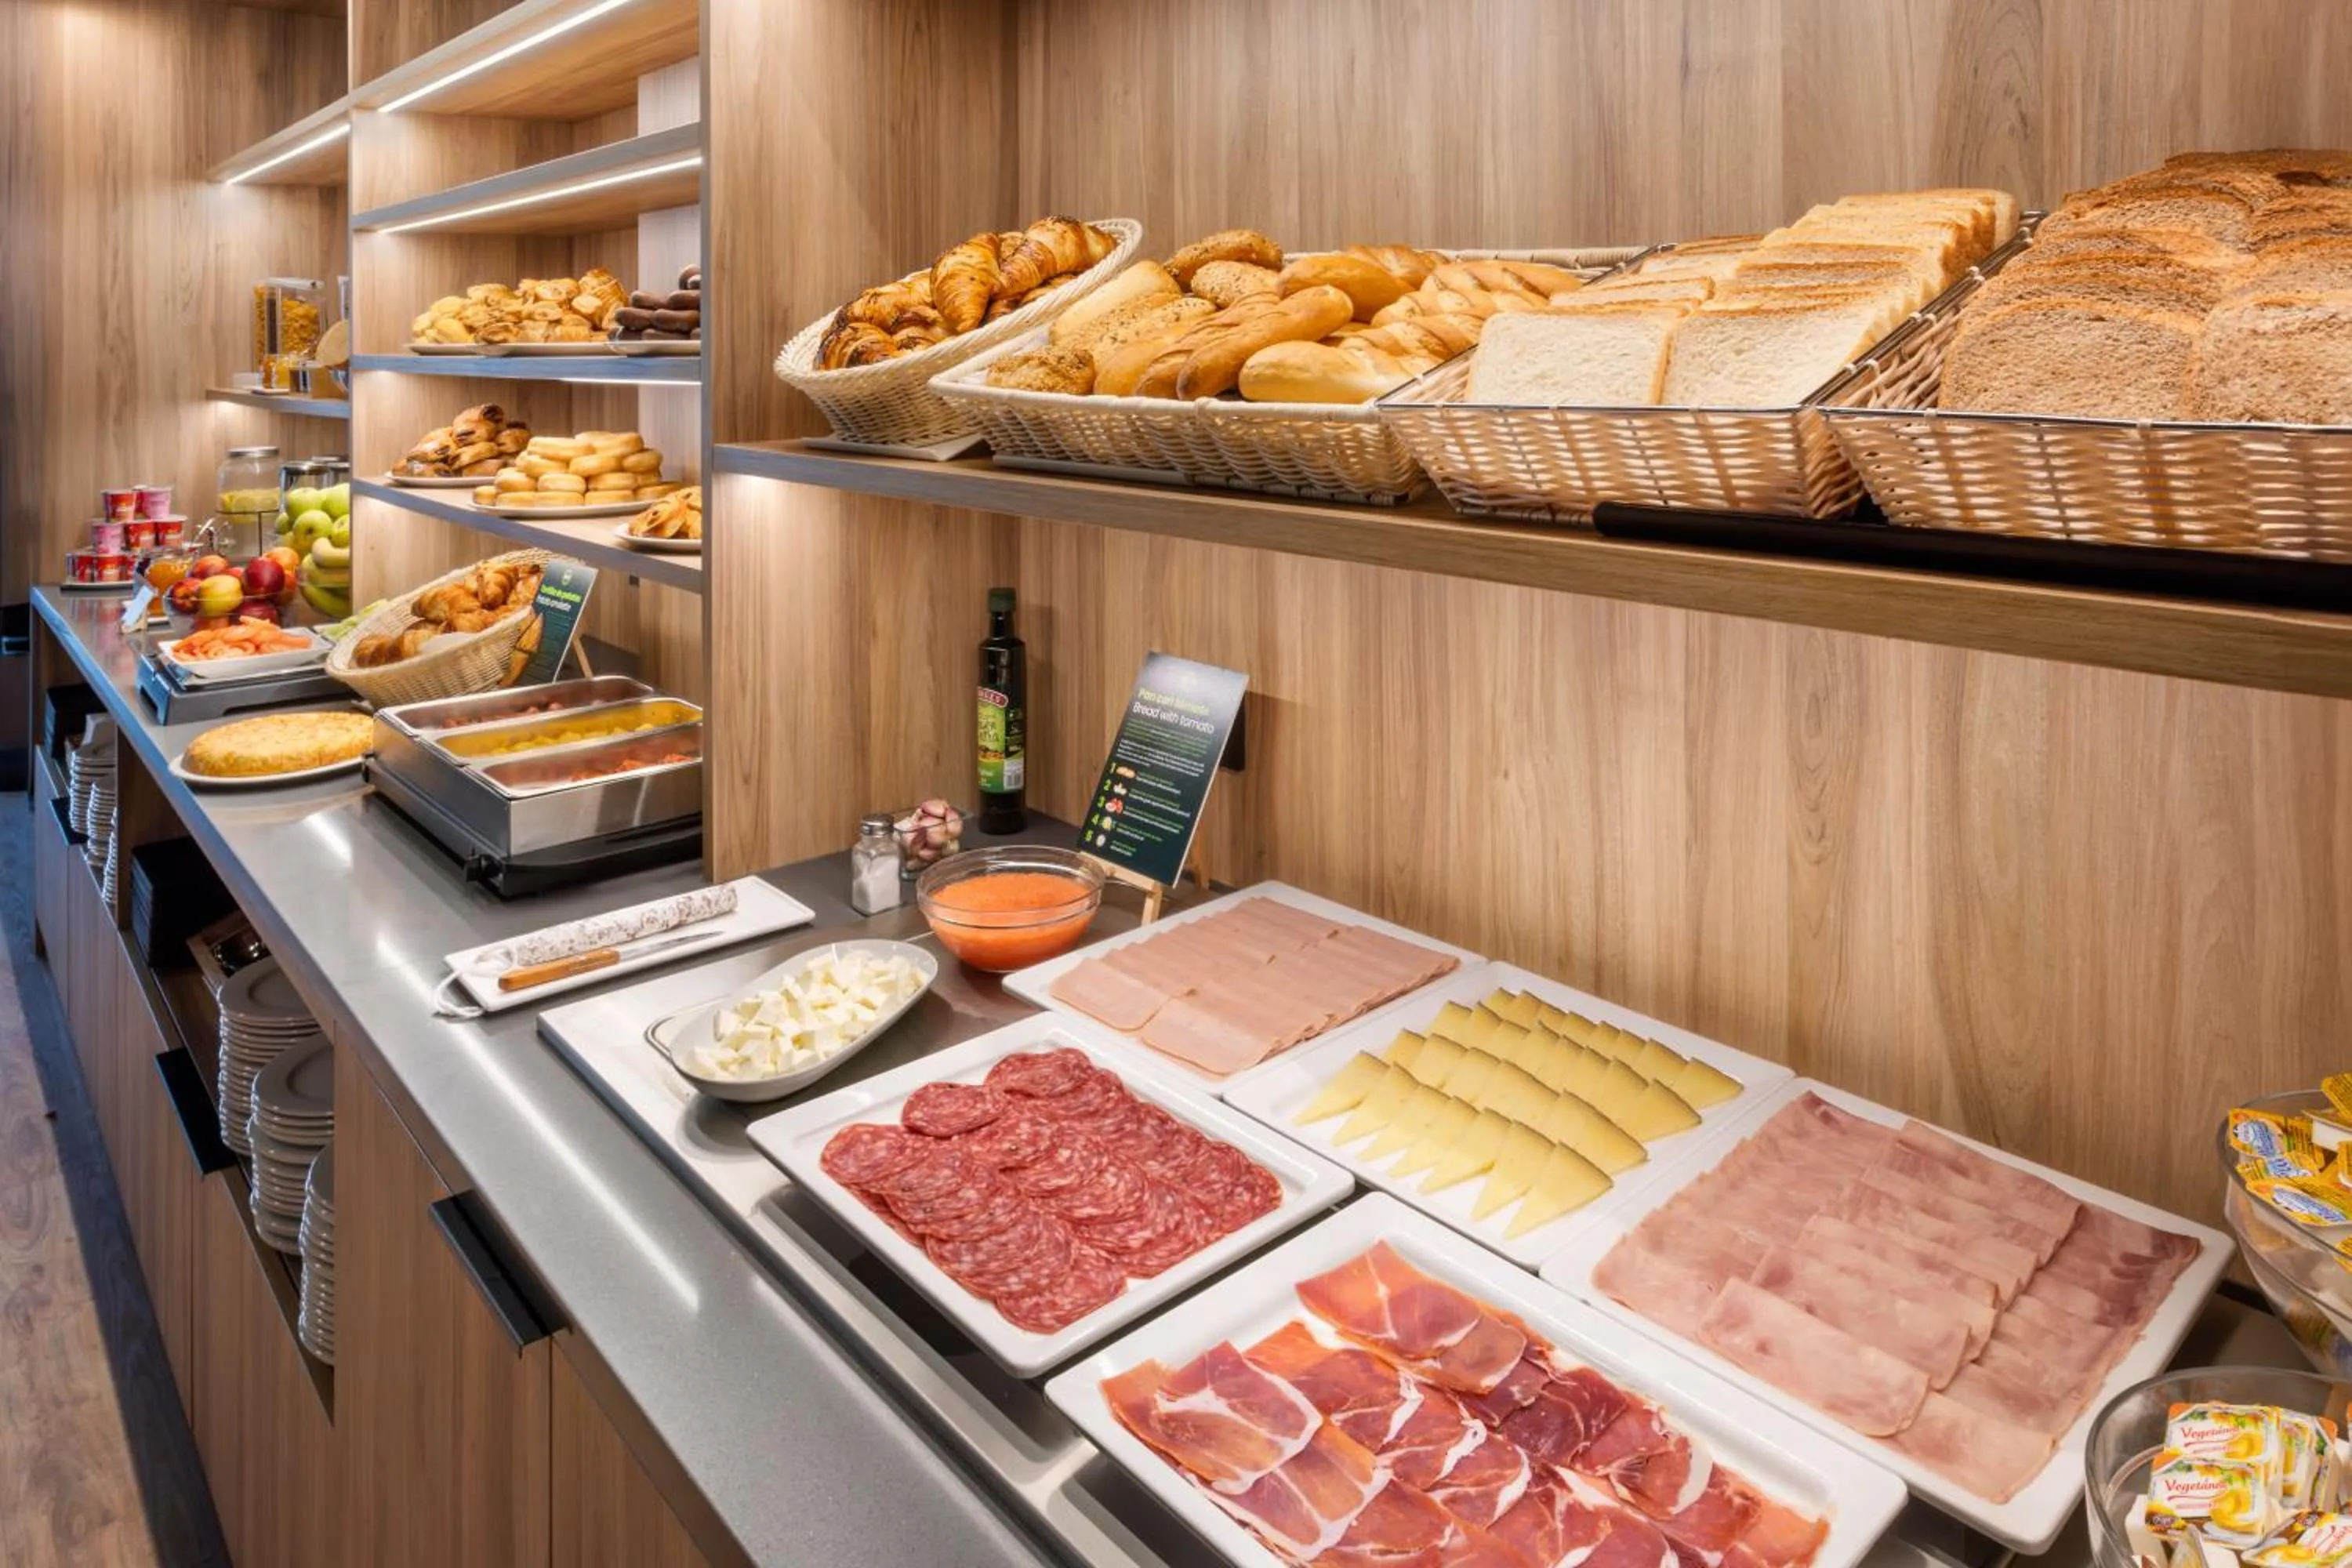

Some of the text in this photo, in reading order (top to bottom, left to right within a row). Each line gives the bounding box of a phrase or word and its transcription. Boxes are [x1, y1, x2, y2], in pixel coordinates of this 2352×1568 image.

[1132, 702, 1214, 735] Bread with tomato
[1103, 779, 1112, 791] 2
